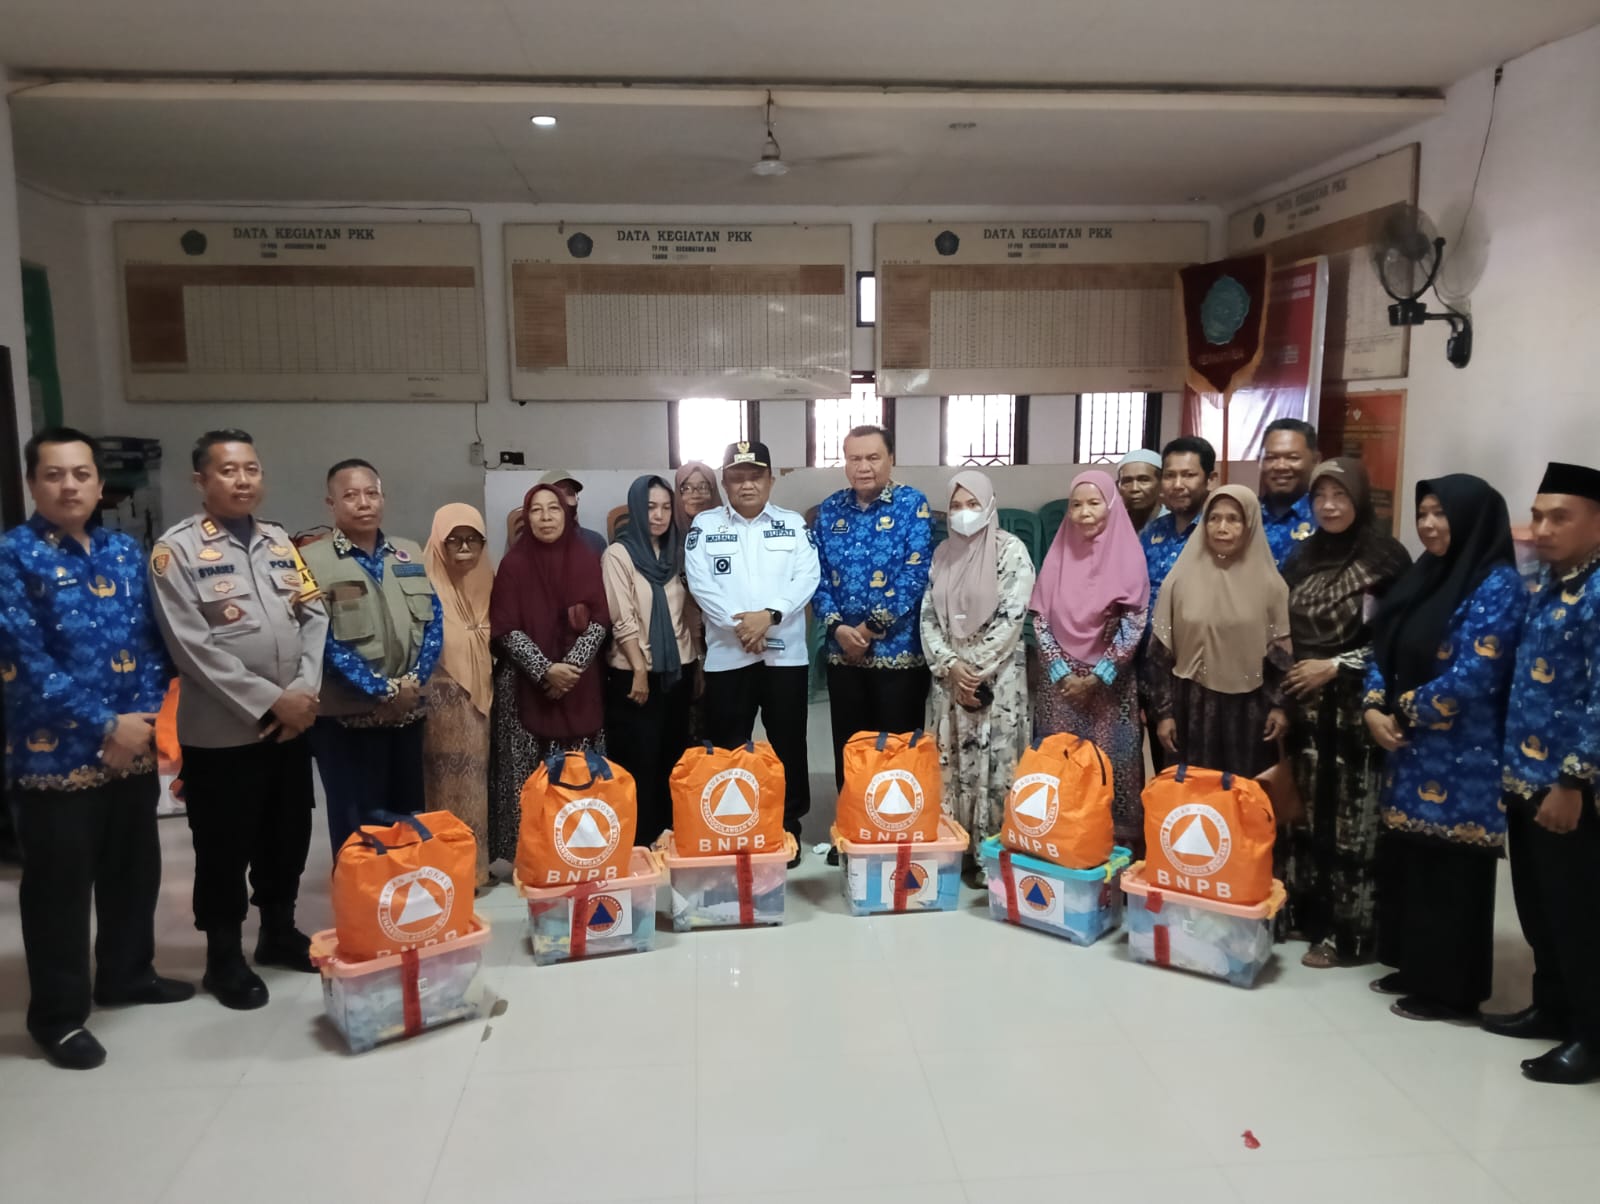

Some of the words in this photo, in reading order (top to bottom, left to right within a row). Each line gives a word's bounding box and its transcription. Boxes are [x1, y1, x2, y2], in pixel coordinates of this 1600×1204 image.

[233, 228, 268, 240] DATA
[275, 228, 341, 240] KEGIATAN
[348, 229, 375, 241] PKK
[617, 230, 650, 242] DATA
[657, 230, 720, 242] KEGIATAN
[727, 231, 753, 243] PKK
[983, 228, 1015, 240] DATA
[1022, 228, 1082, 239] KEGIATAN
[1088, 227, 1113, 239] PKK
[699, 834, 766, 852] BNPB
[859, 828, 925, 843] BNPB
[1008, 828, 1059, 858] BNPB
[546, 866, 618, 884] BNPB
[1156, 869, 1232, 898] BNPB
